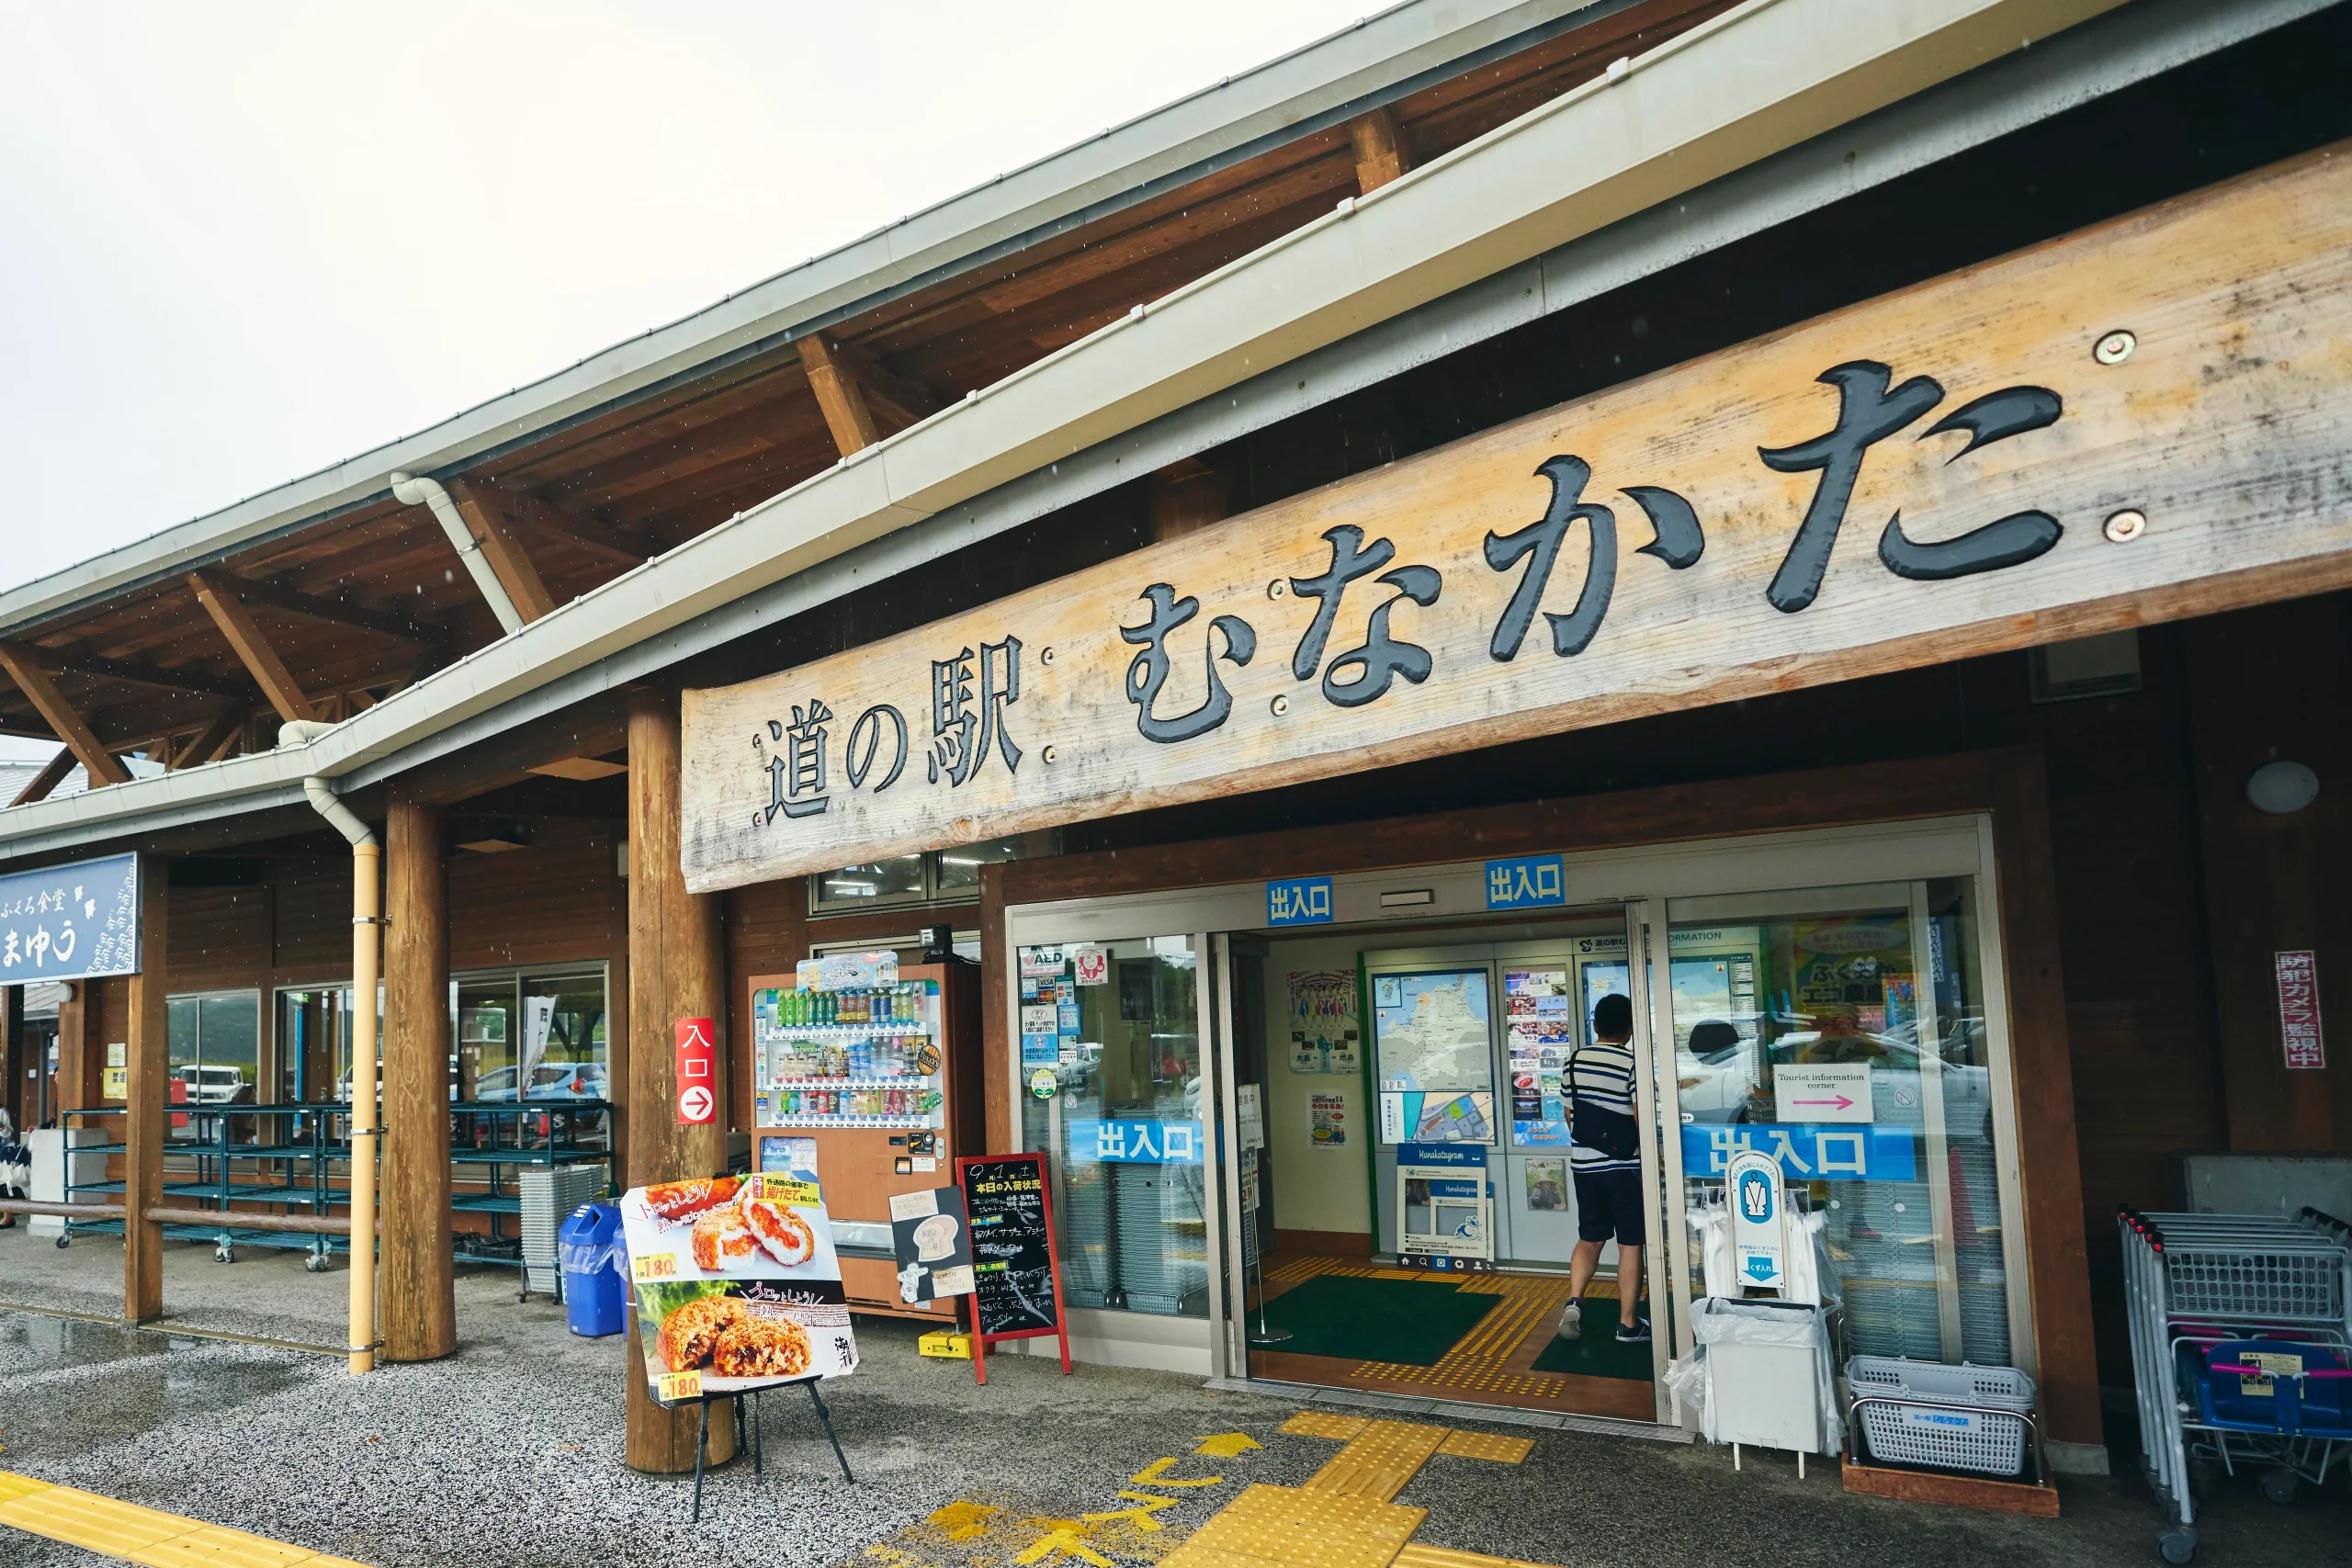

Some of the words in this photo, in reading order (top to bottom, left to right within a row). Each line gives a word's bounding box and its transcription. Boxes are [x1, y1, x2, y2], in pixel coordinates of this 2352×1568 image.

[764, 634, 1023, 825] 道の駅
[1120, 358, 2064, 743] むなかた
[1490, 863, 1561, 903] 出入口
[0, 887, 66, 919] ふくろ食堂
[1271, 885, 1329, 920] 出入口
[3, 919, 75, 967] まゆう
[1034, 953, 1063, 964] AED
[2278, 954, 2320, 1066] 防犯カメラ監視中
[682, 1025, 711, 1077] 入口
[1778, 1073, 1810, 1081] Tourist
[1812, 1073, 1864, 1081] information
[1098, 1122, 1193, 1160] 出入口
[1419, 1149, 1464, 1163] Munakatagram
[1710, 1128, 1867, 1175] 出入口
[766, 1185, 801, 1201] 揚げたて
[976, 1179, 1042, 1194] 本日の入荷状況
[1749, 1264, 1772, 1272] くず入れ
[1934, 1416, 1969, 1426] むなかた
